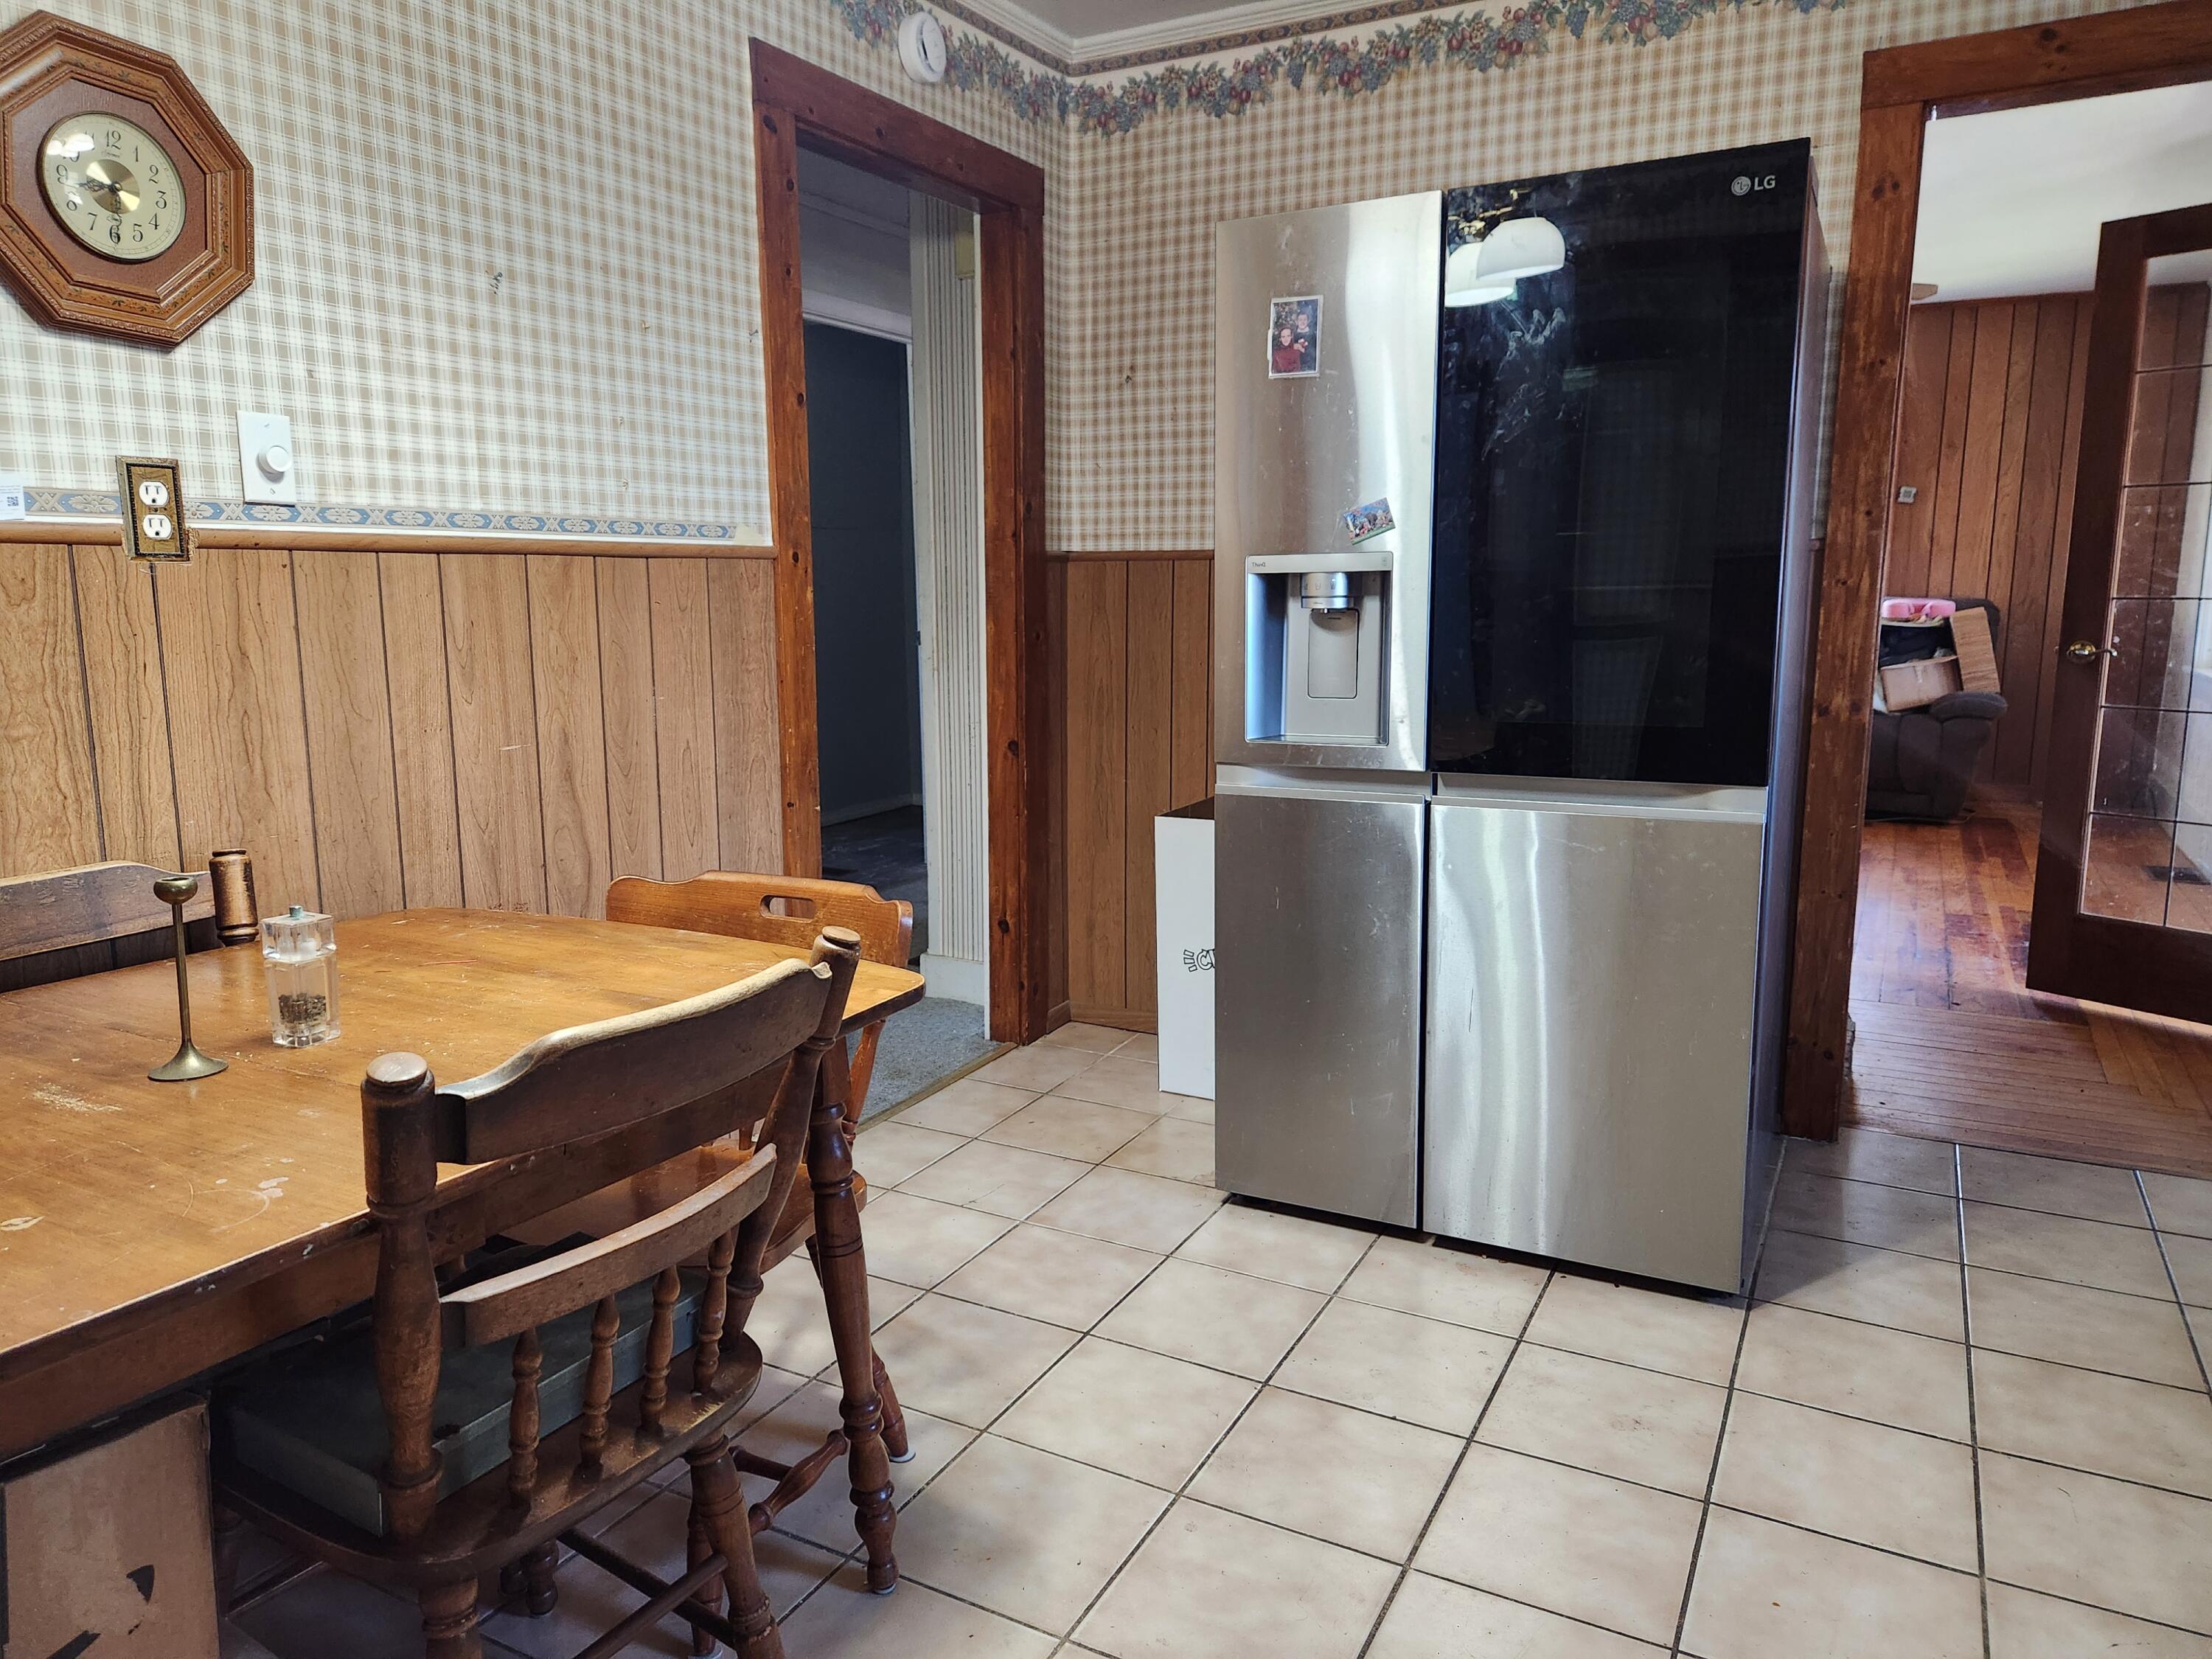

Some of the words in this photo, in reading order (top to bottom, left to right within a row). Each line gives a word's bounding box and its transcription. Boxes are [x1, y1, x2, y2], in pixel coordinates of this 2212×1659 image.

[106, 130, 121, 150] 12
[133, 145, 139, 162] 1
[56, 164, 69, 184] 9
[149, 164, 159, 184] 2
[1755, 175, 1775, 190] LG
[156, 190, 167, 209] 3
[88, 212, 97, 231] 7
[148, 212, 160, 230] 4
[109, 224, 121, 244] 6
[133, 223, 143, 243] 5
